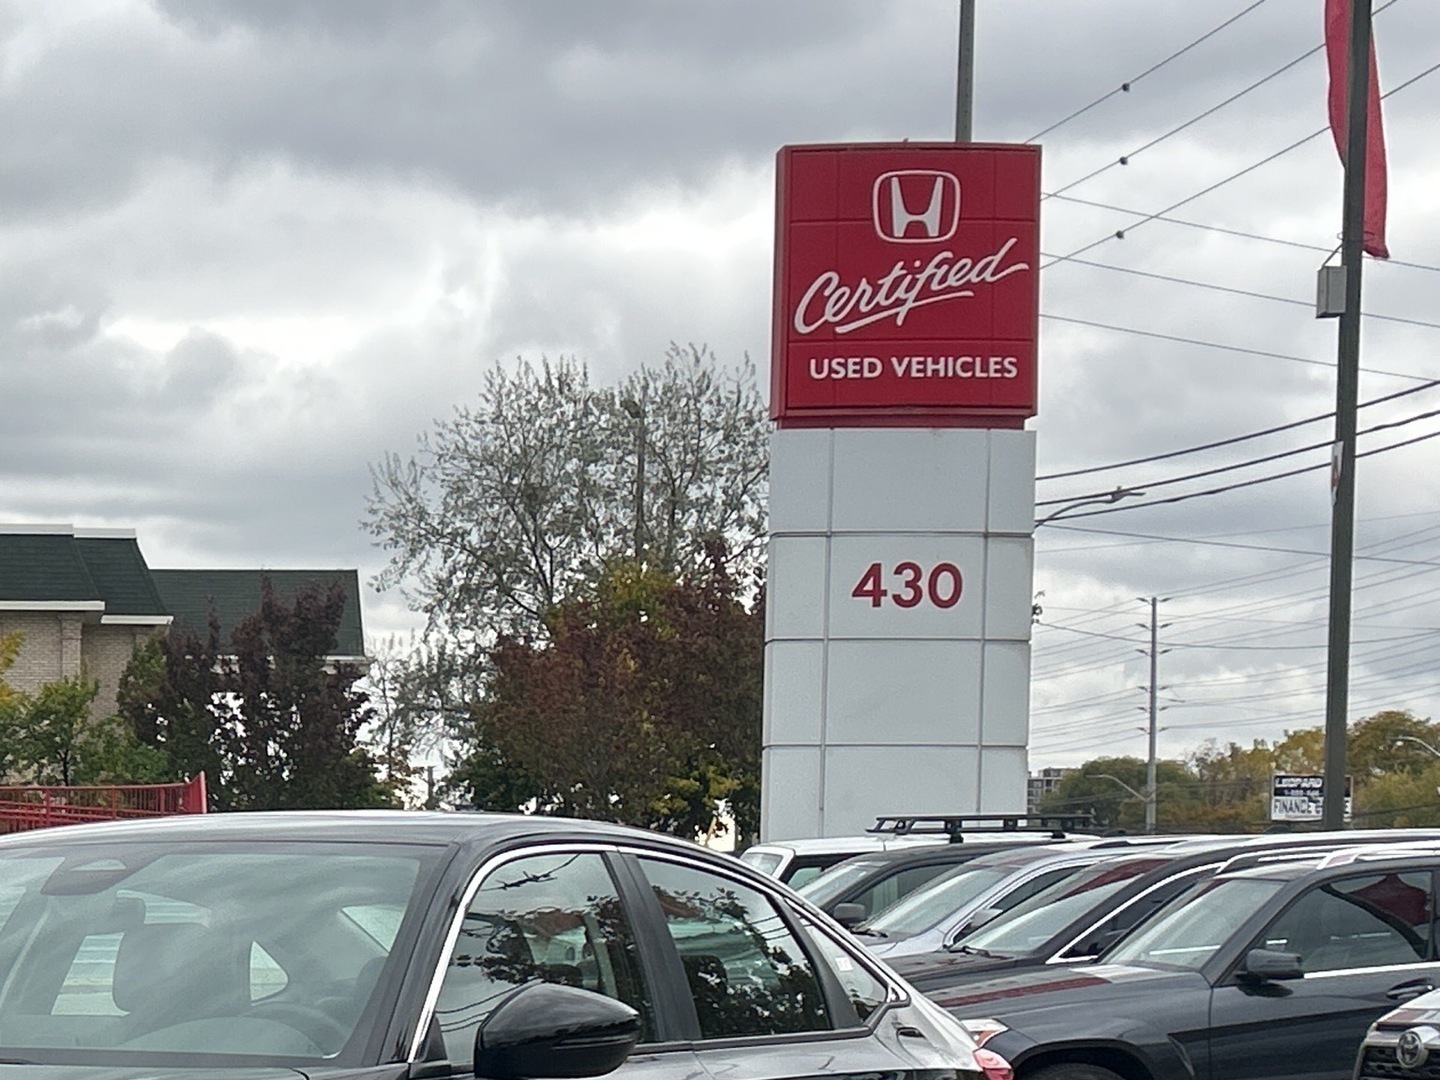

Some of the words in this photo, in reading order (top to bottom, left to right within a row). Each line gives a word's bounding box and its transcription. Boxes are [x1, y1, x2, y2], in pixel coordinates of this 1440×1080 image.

[794, 238, 1029, 333] Certified
[810, 358, 883, 379] USED
[891, 357, 1018, 378] VEHICLES
[851, 562, 963, 608] 430
